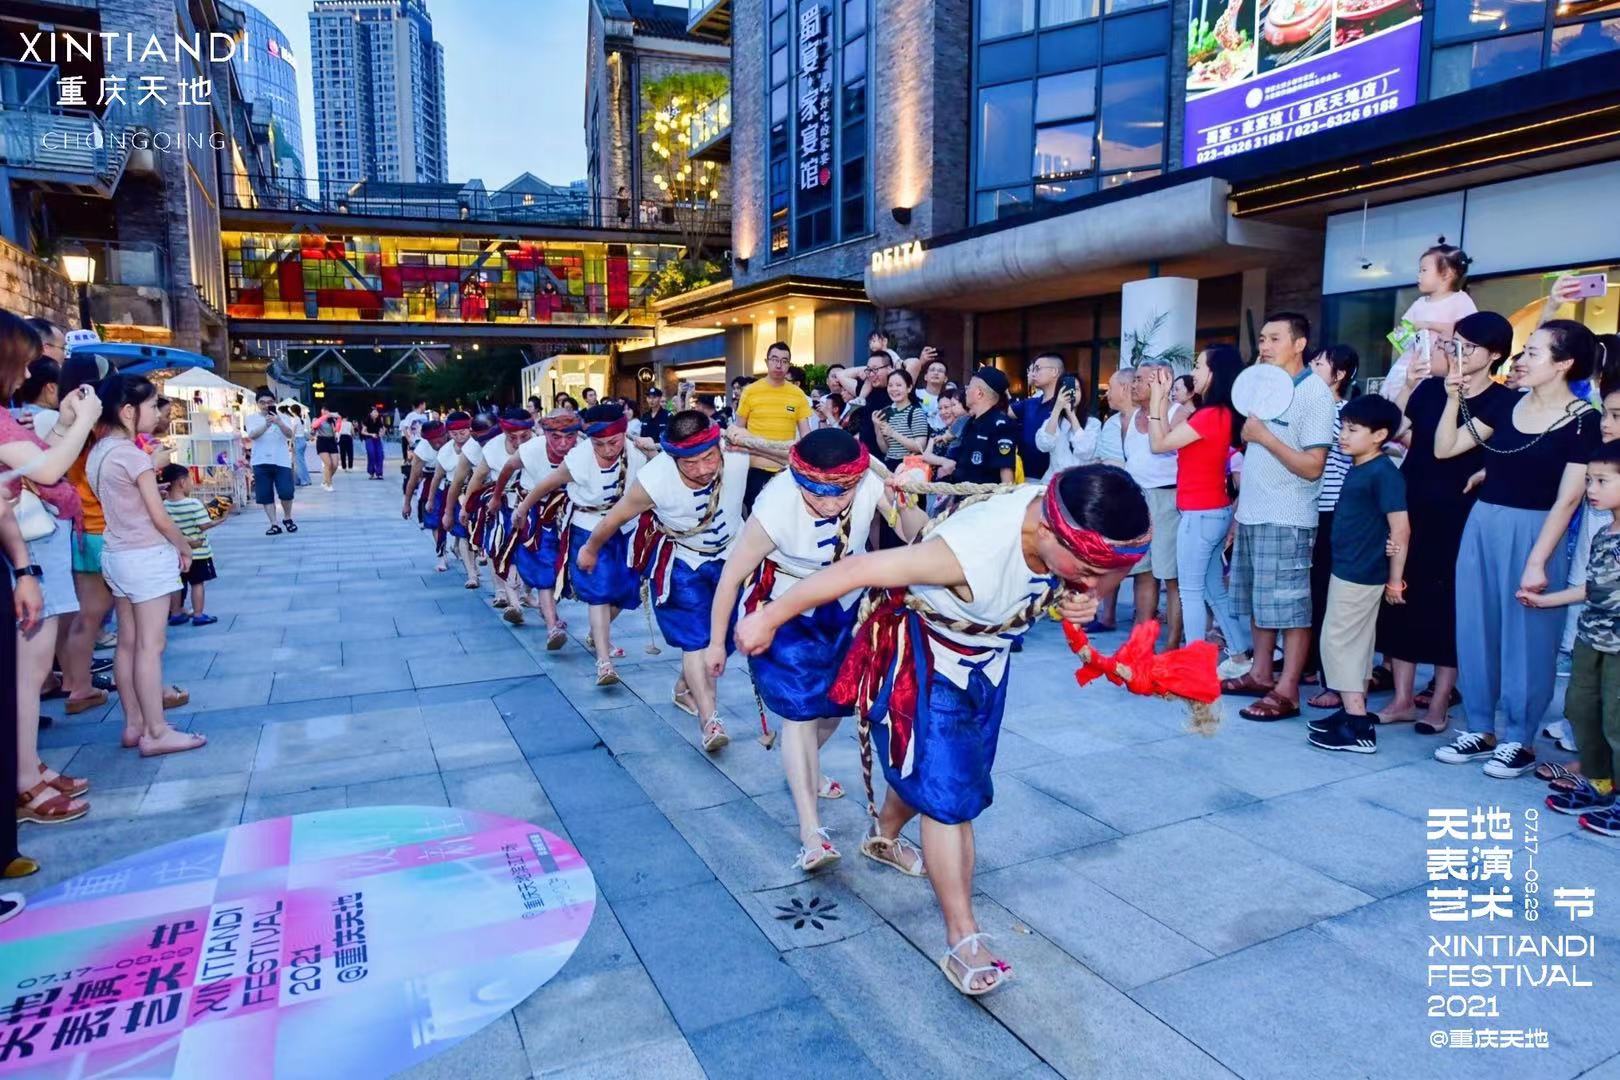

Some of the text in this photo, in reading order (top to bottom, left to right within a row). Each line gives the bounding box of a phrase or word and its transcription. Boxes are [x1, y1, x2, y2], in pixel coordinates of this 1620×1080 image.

[872, 240, 924, 272] DELTA
[193, 906, 244, 1018] XINTIANDI
[242, 900, 283, 1006] FESTIVAL
[289, 944, 321, 996] 2021
[332, 892, 368, 983] @重庆天地
[51, 974, 128, 1051] 表演
